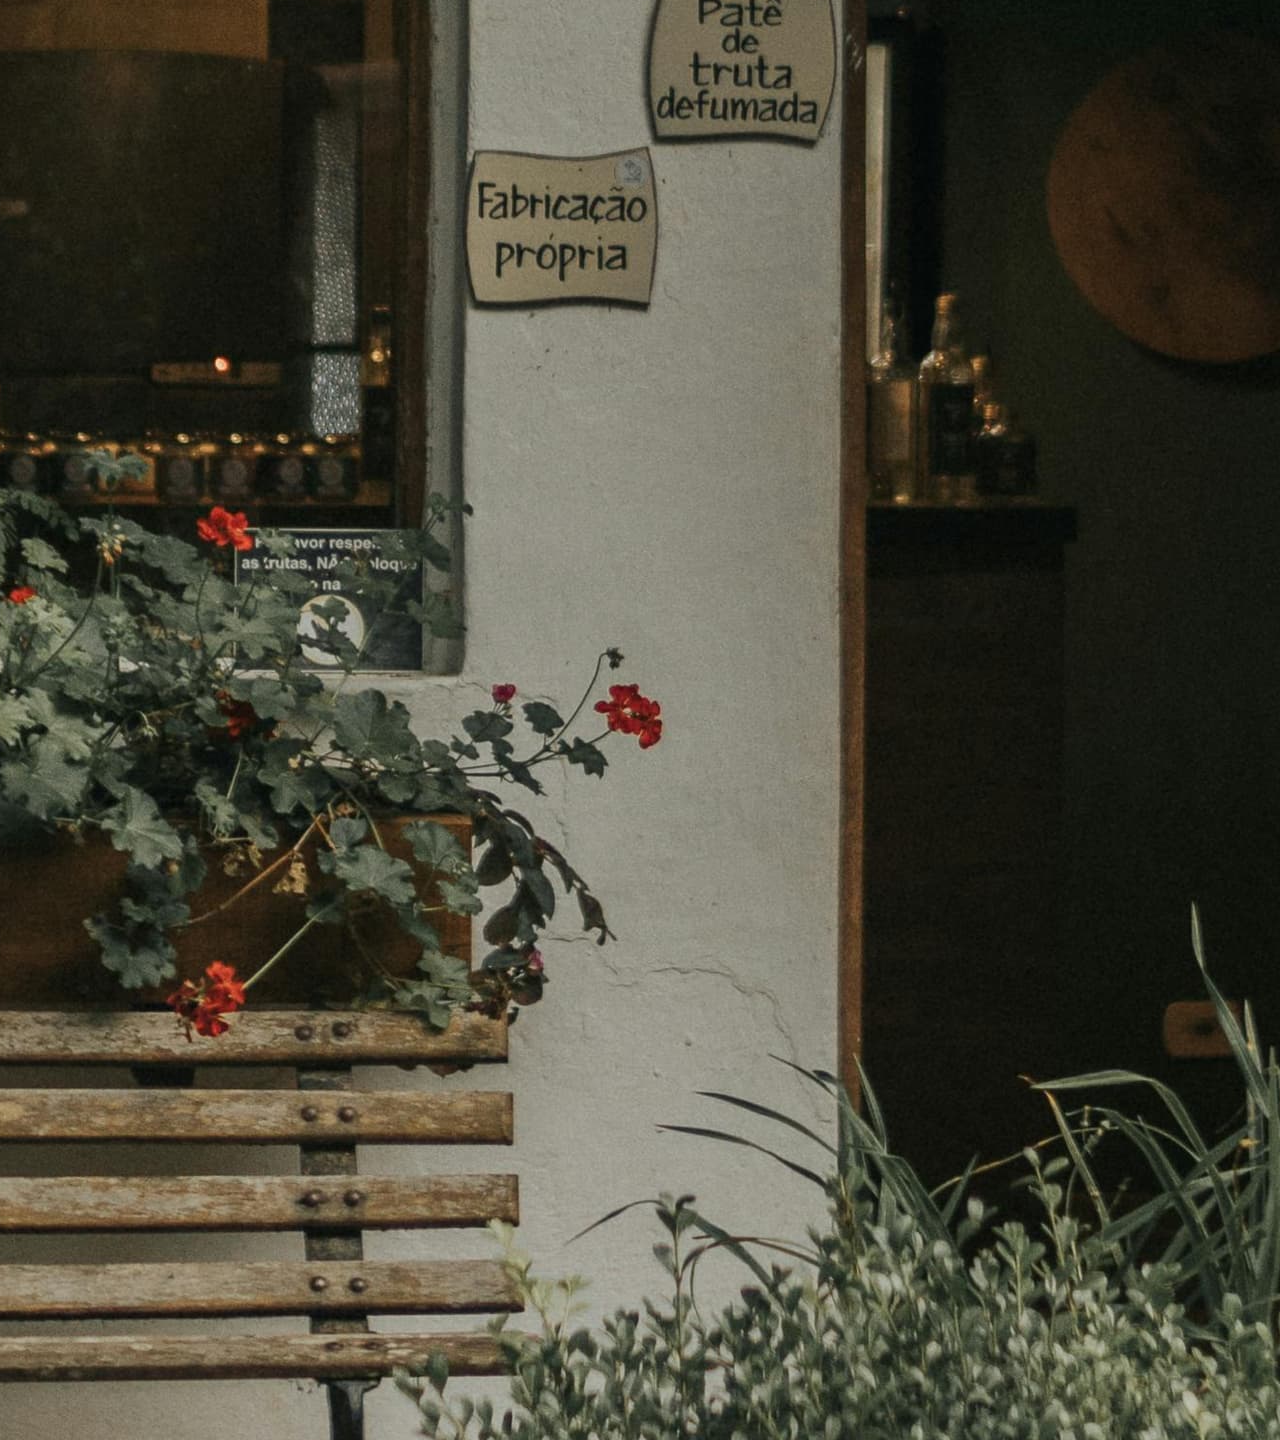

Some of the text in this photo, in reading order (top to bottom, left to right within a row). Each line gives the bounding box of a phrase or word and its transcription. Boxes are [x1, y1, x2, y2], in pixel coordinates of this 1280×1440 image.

[721, 27, 760, 55] de
[688, 52, 793, 90] truta
[656, 86, 819, 125] defumada
[477, 182, 648, 226] Fabricação
[495, 232, 628, 283] própria
[241, 558, 260, 570] as
[316, 553, 351, 570] NÃ
[322, 579, 342, 591] na
